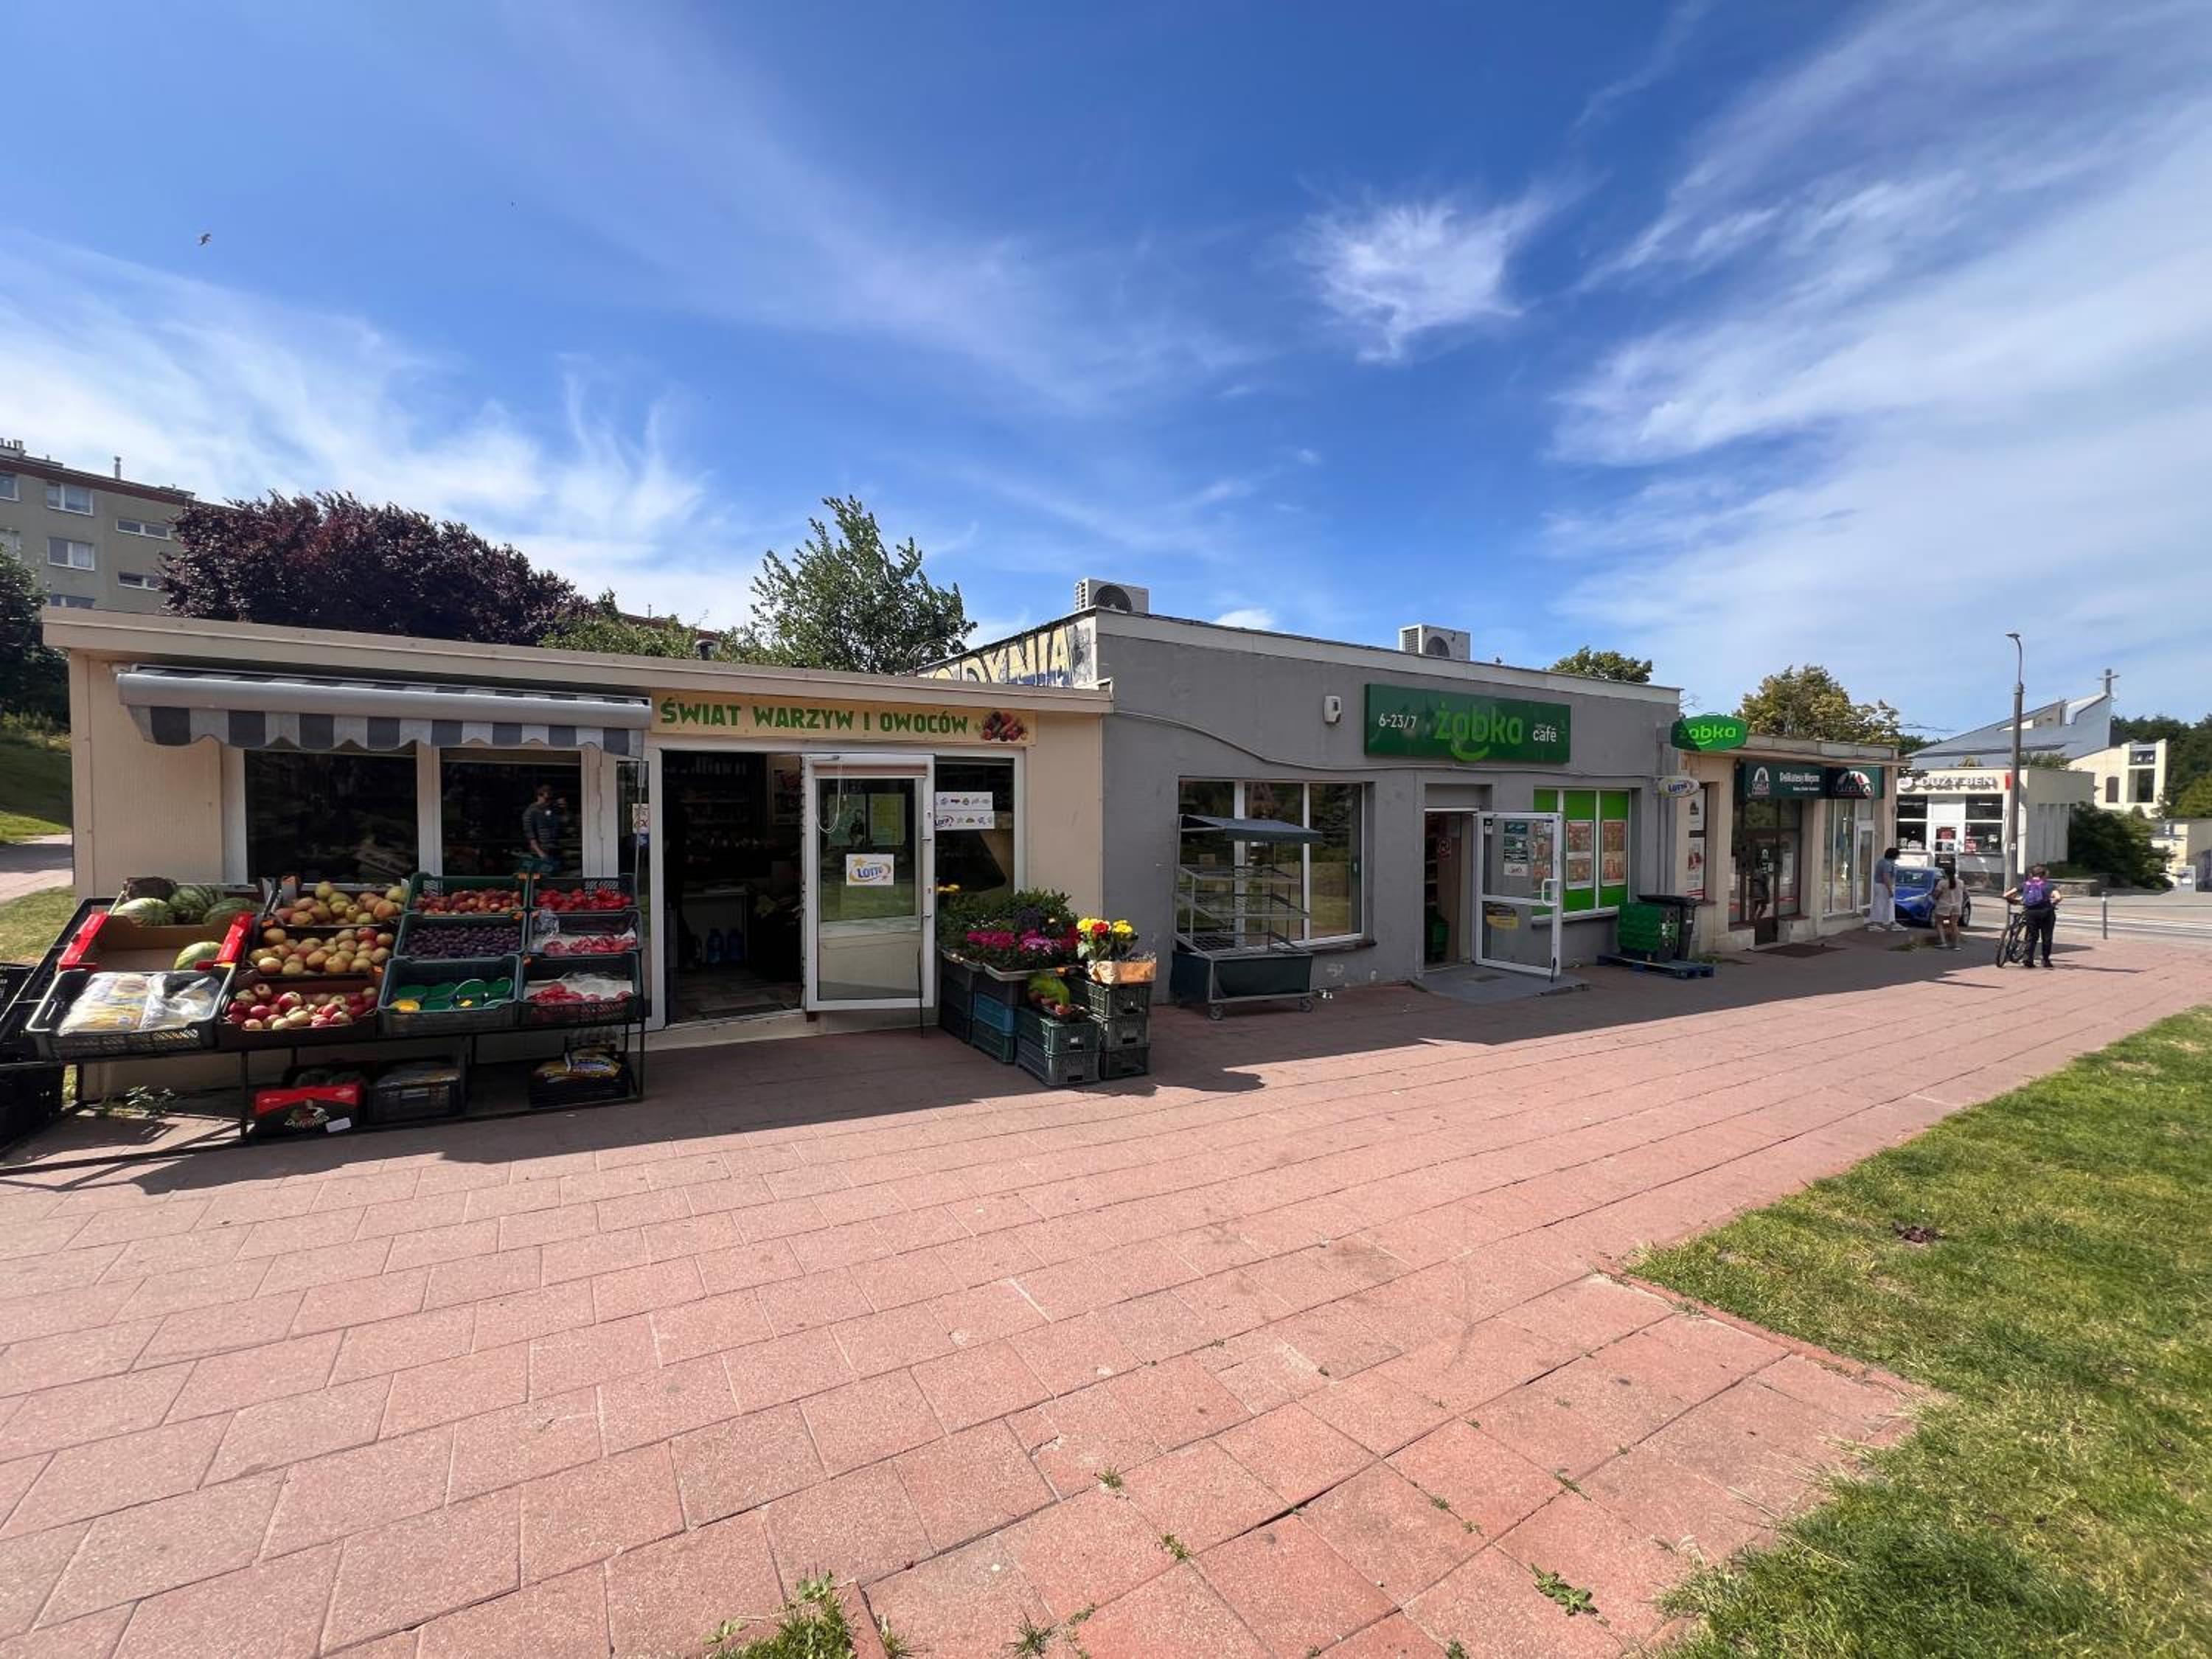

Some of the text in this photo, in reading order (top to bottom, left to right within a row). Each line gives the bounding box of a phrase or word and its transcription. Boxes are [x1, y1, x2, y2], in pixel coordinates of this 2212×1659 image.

[660, 698, 969, 734] ŚWIAT WARZYW I OWOCÓW
[1378, 712, 1417, 730] 6-23/7
[1435, 701, 1523, 745] żabka
[1533, 724, 1557, 742] café
[857, 866, 883, 880] LOTTO
